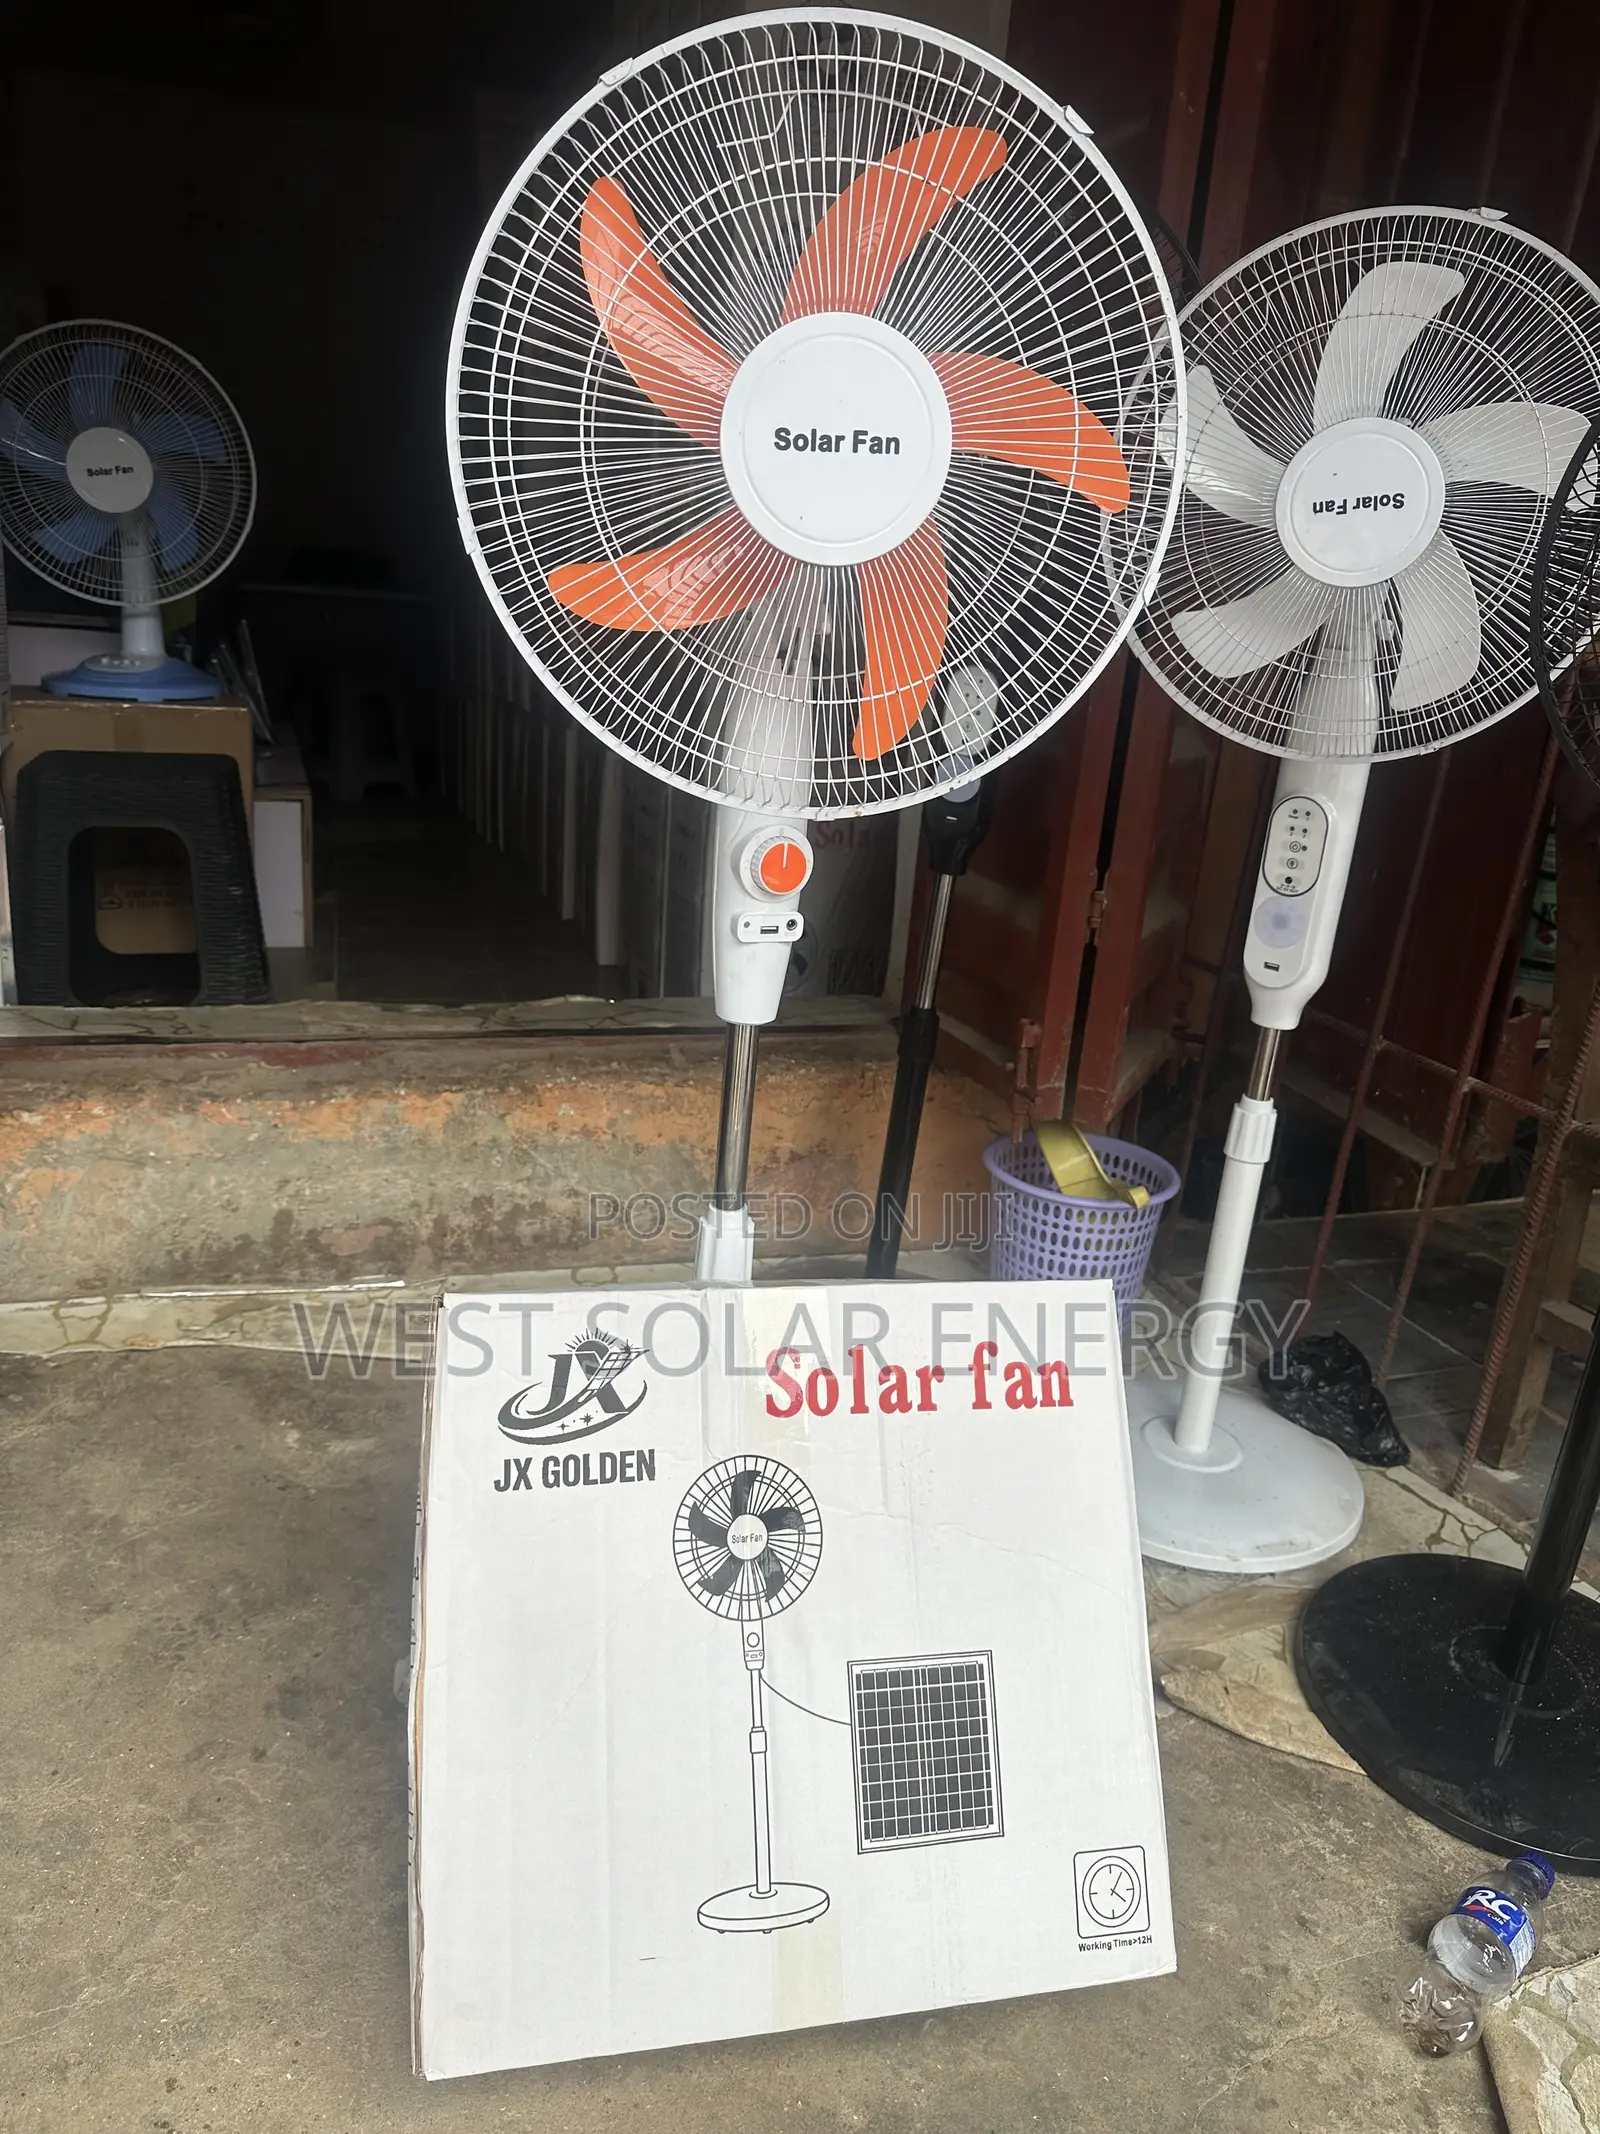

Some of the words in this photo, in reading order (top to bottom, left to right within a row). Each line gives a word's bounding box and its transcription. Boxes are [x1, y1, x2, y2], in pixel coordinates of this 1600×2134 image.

[774, 427, 846, 453] Solar
[852, 429, 900, 455] Fan
[87, 467, 113, 477] Solar
[115, 466, 134, 475] Fan
[1312, 499, 1347, 515] Fan
[1352, 493, 1405, 511] Solar
[766, 1343, 946, 1419] Solar
[968, 1341, 1075, 1411] fan
[494, 1457, 533, 1492] JX
[541, 1449, 656, 1489] GOLDEN
[731, 1534, 748, 1544] Solar
[750, 1533, 763, 1543] Fan
[1462, 1889, 1519, 1920] RC
[1078, 1940, 1112, 1952] Working
